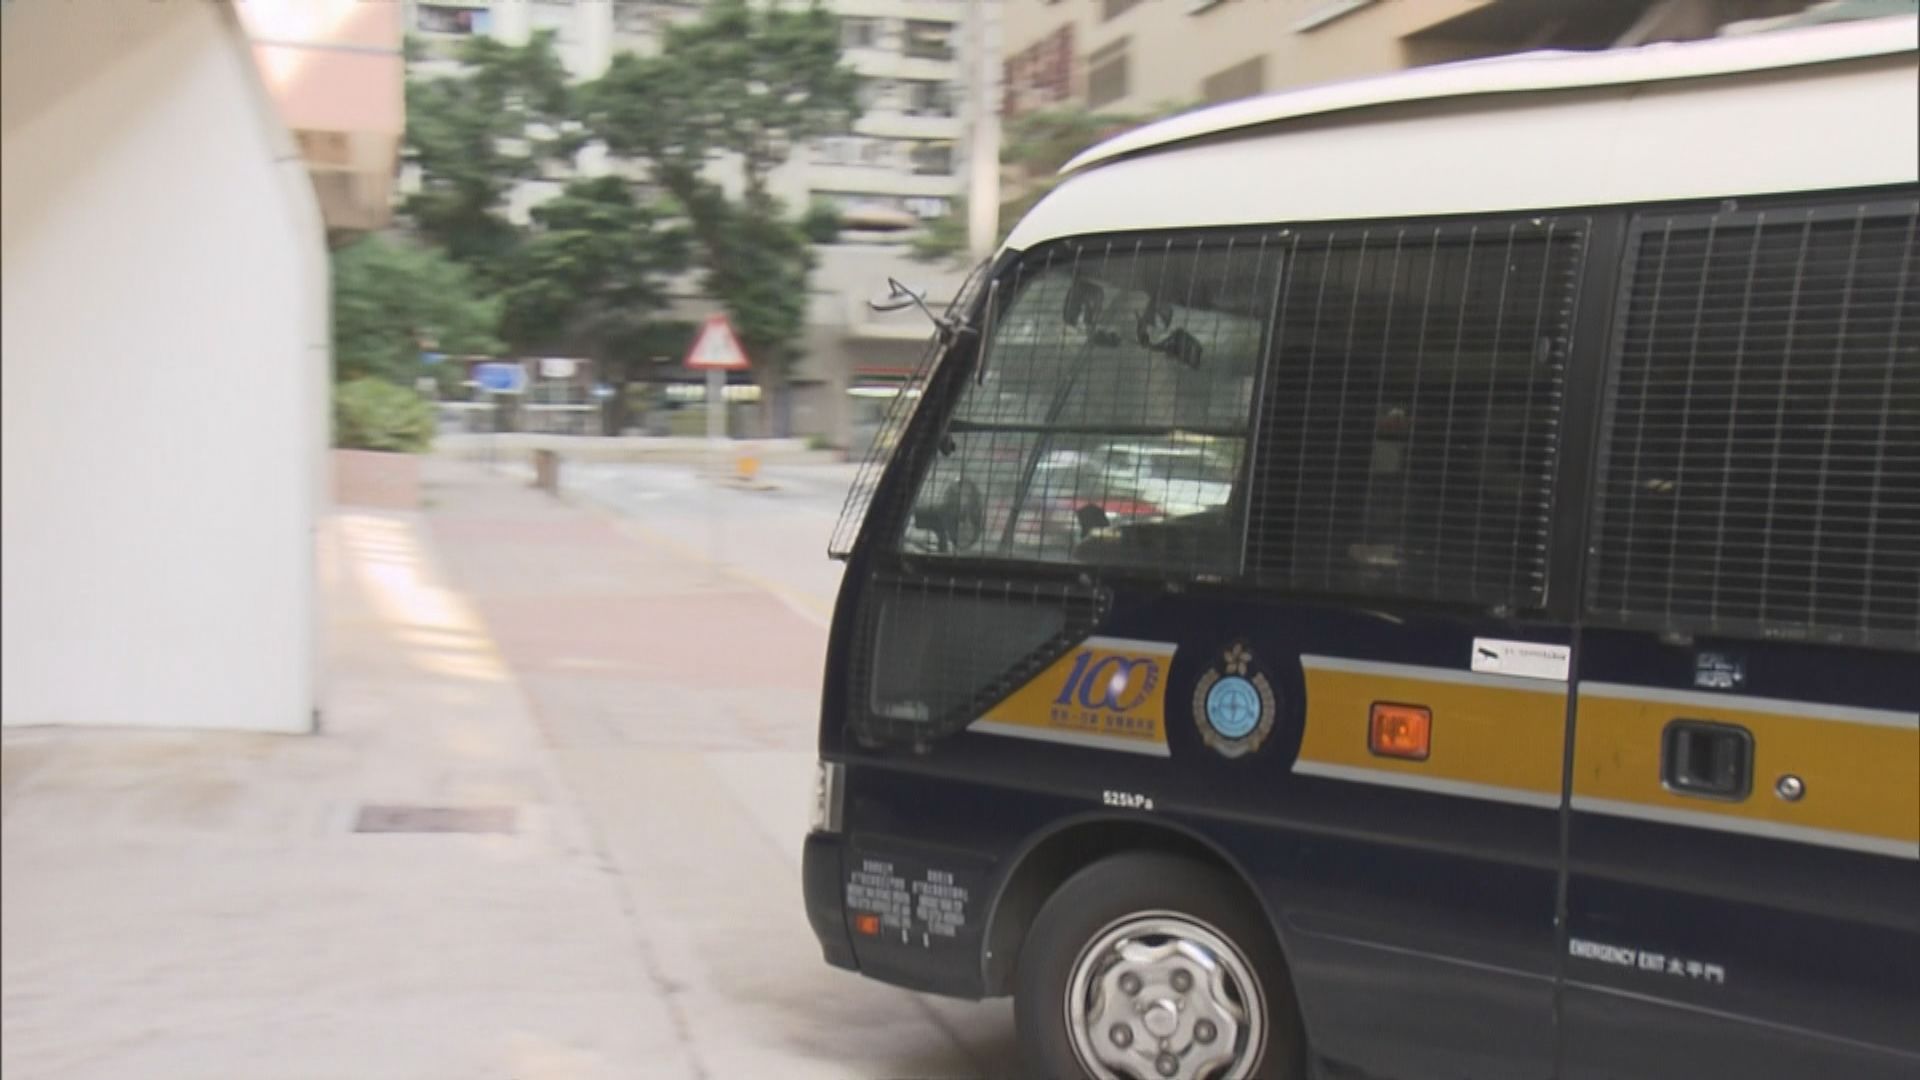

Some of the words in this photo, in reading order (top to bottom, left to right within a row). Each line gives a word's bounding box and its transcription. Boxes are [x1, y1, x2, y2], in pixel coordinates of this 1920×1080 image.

[1053, 649, 1159, 712] 100
[1103, 789, 1154, 811] 525kPa
[1569, 937, 1635, 966] EMERGENCY
[1637, 950, 1665, 972] EXIT
